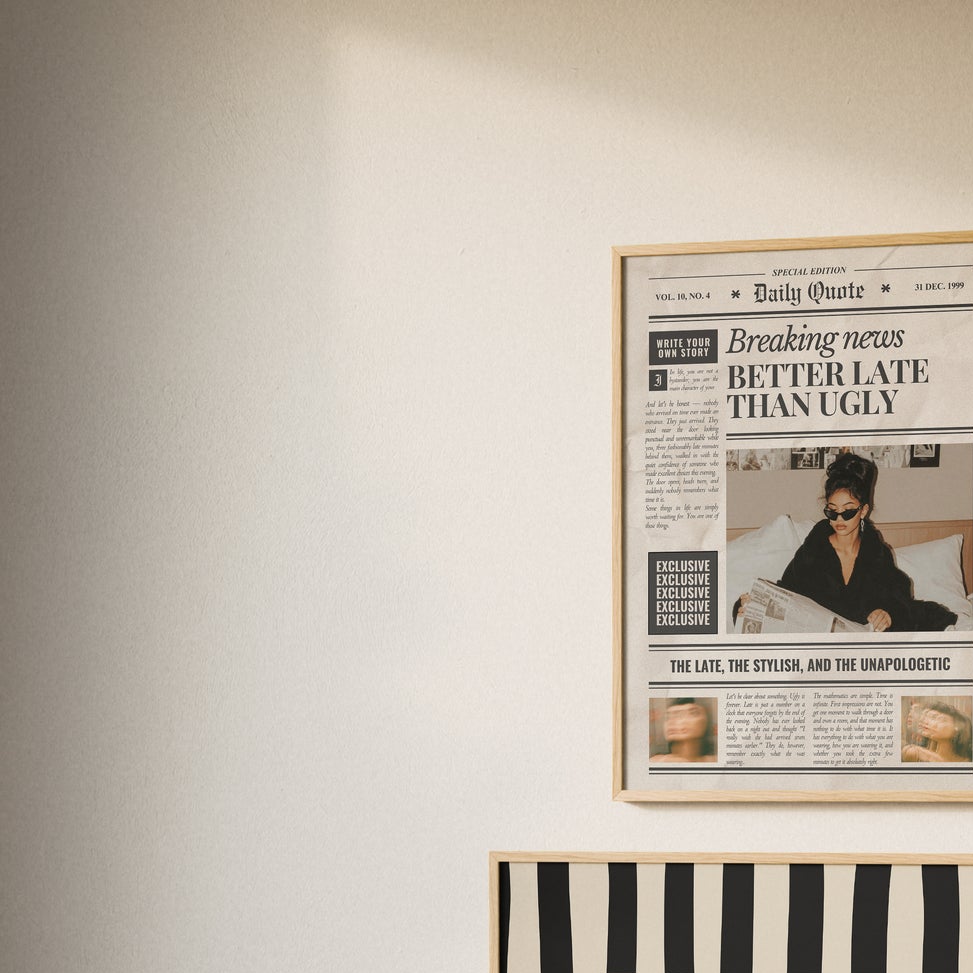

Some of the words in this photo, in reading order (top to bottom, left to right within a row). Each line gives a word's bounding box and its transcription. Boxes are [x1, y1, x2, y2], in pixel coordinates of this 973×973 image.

[772, 267, 808, 276] SPECIAL
[810, 266, 846, 275] EDITION
[754, 282, 801, 306] Daily
[808, 280, 865, 304] Quote
[656, 339, 683, 348] WRITE
[687, 338, 710, 347] YOUR
[725, 324, 839, 358] Breaking
[843, 328, 905, 350] news
[658, 349, 677, 358] OWN
[681, 348, 709, 357] STORY
[728, 362, 845, 389] BETTER
[852, 359, 929, 386] LATE
[726, 392, 811, 419] THAN
[819, 389, 899, 416] UGLY
[656, 560, 710, 572] EXCLUSIVE
[656, 573, 710, 586] EXCLUSIVE
[656, 587, 710, 599] EXCLUSIVE
[656, 600, 710, 612] EXCLUSIVE
[656, 614, 710, 626] EXCLUSIVE
[670, 660, 691, 672] THE
[695, 660, 724, 674] LATE,
[728, 660, 749, 672] THE
[753, 659, 803, 674] STYLISH,
[807, 659, 831, 671] AND
[835, 658, 856, 671] THE
[861, 657, 950, 671] UNAPOLOGETIC
